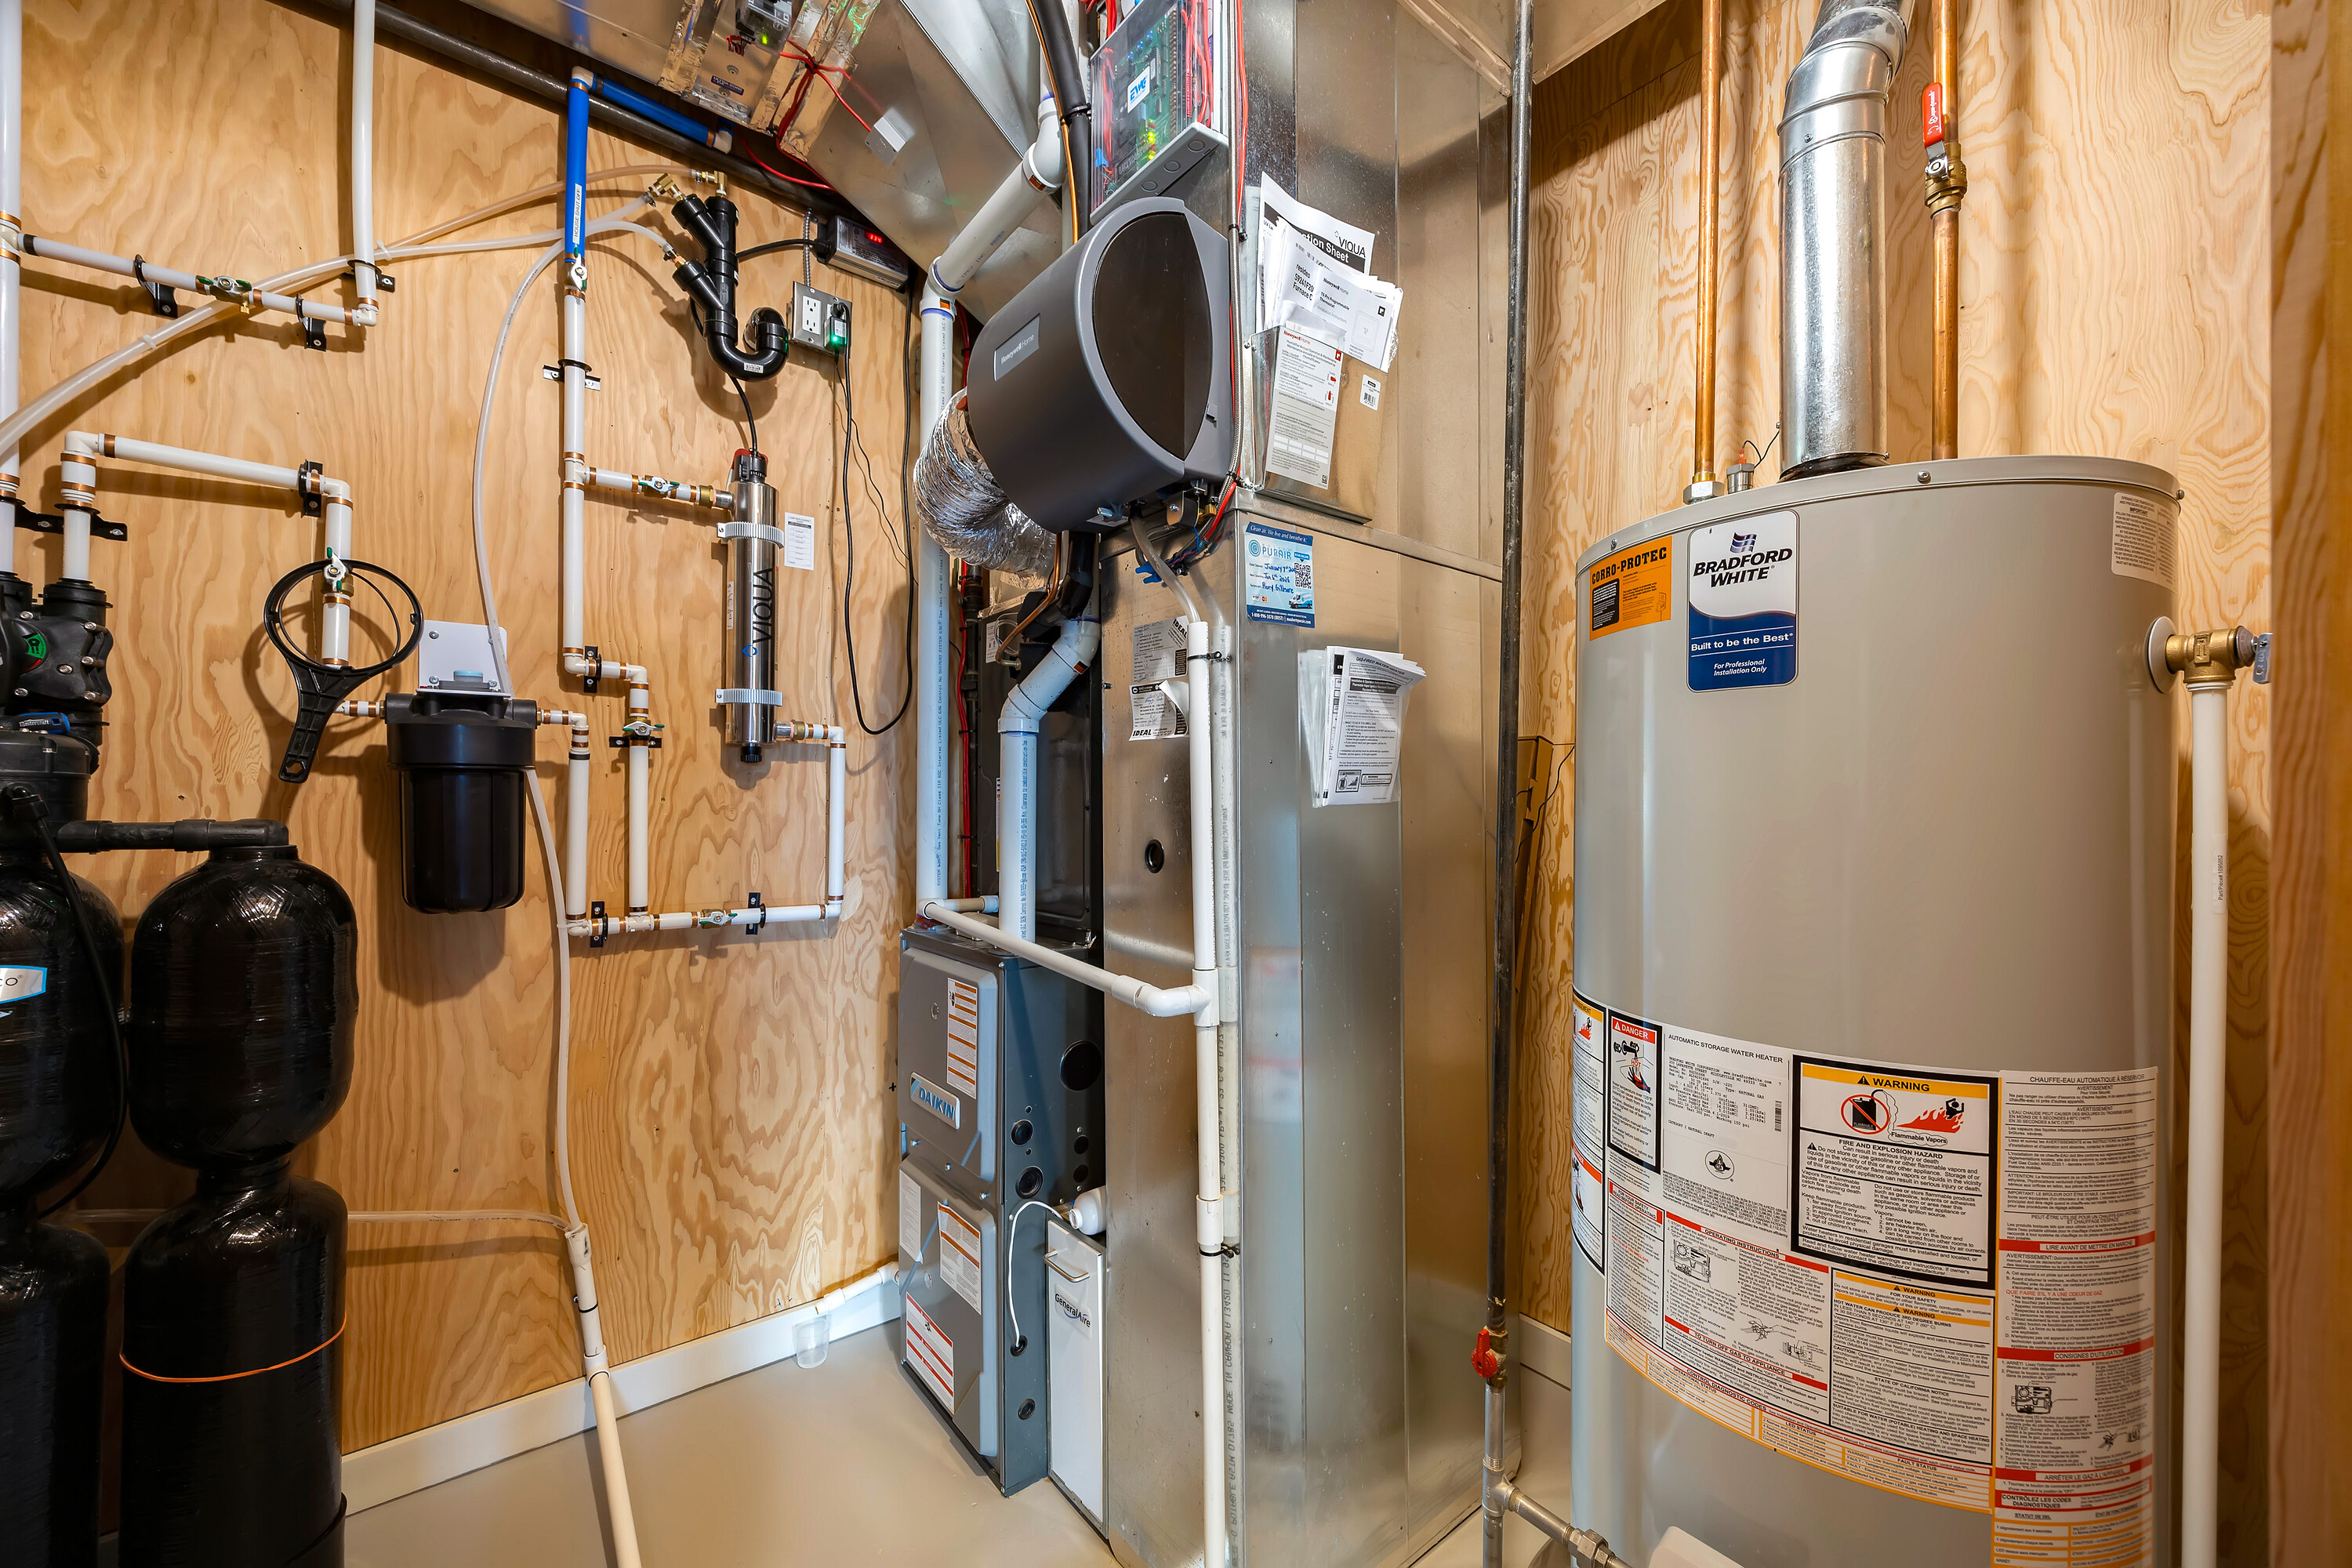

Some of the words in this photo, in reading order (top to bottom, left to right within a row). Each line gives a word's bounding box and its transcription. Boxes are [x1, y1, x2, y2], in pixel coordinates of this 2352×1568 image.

[1327, 241, 1348, 263] Sheet
[1338, 236, 1366, 257] VIQUA
[1293, 282, 1309, 298] Furnace
[1323, 278, 1340, 290] Honeywell
[1319, 297, 1335, 308] Thermostat
[1330, 296, 1349, 310] Programmable
[1331, 312, 1347, 323] Instructions
[1283, 330, 1301, 340] Honeywell
[1001, 343, 1022, 364] Honeywell
[1022, 335, 1034, 347] Home
[1262, 546, 1291, 560] PURAIR
[1592, 547, 1667, 585] CORRO-PROTEC
[1693, 548, 1793, 577] BRADFORD
[753, 568, 774, 644] VIQUA
[1173, 618, 1188, 639] IDEAL
[1691, 640, 1711, 652] Built
[1743, 636, 1760, 645] the
[1389, 666, 1405, 675] HEATER
[1725, 659, 1765, 669] Professional
[1714, 667, 1750, 676] Installation
[1621, 1024, 1649, 1040] DANGER
[1668, 1034, 1700, 1047] AUTOMATIC
[1700, 1042, 1730, 1053] STORAGE
[1730, 1048, 1755, 1058] WATER
[1755, 1053, 1784, 1063] HEATER
[1697, 1064, 1719, 1073] CORPORATION
[1723, 1071, 1772, 1084] www.bradfordwhite.com
[1873, 1078, 1929, 1091] WARNING
[919, 1087, 955, 1120] DAIKIN
[1891, 1132, 1924, 1142] Flammable
[1872, 1145, 1912, 1156] EXPLOSION
[1834, 1176, 1860, 1185] flammable
[1705, 1229, 1736, 1244] OPERATING
[1737, 1241, 1779, 1258] INSTRUCTIONS
[1903, 1287, 1936, 1298] WARNING
[1055, 1294, 1091, 1327] GeneralAire
[1845, 1301, 1863, 1310] WATER
[1876, 1308, 1900, 1318] PRODUCE
[1903, 1308, 1936, 1319] WARNING
[1704, 1337, 1716, 1346] TURN
[1730, 1349, 1741, 1358] GAS
[1752, 1359, 1785, 1375] APPLIANCE
[2090, 1348, 2124, 1358] D'UTILISATION
[1686, 1369, 1711, 1385] CONTROL
[1711, 1381, 1746, 1402] DIAGNOSTIC
[1746, 1399, 1767, 1411] CODES
[1900, 1381, 1929, 1393] CALIFORNIA
[1797, 1425, 1817, 1436] STATUS
[1897, 1457, 1919, 1466] FAULT
[2002, 1494, 2038, 1502] CONTRÔLEZ
